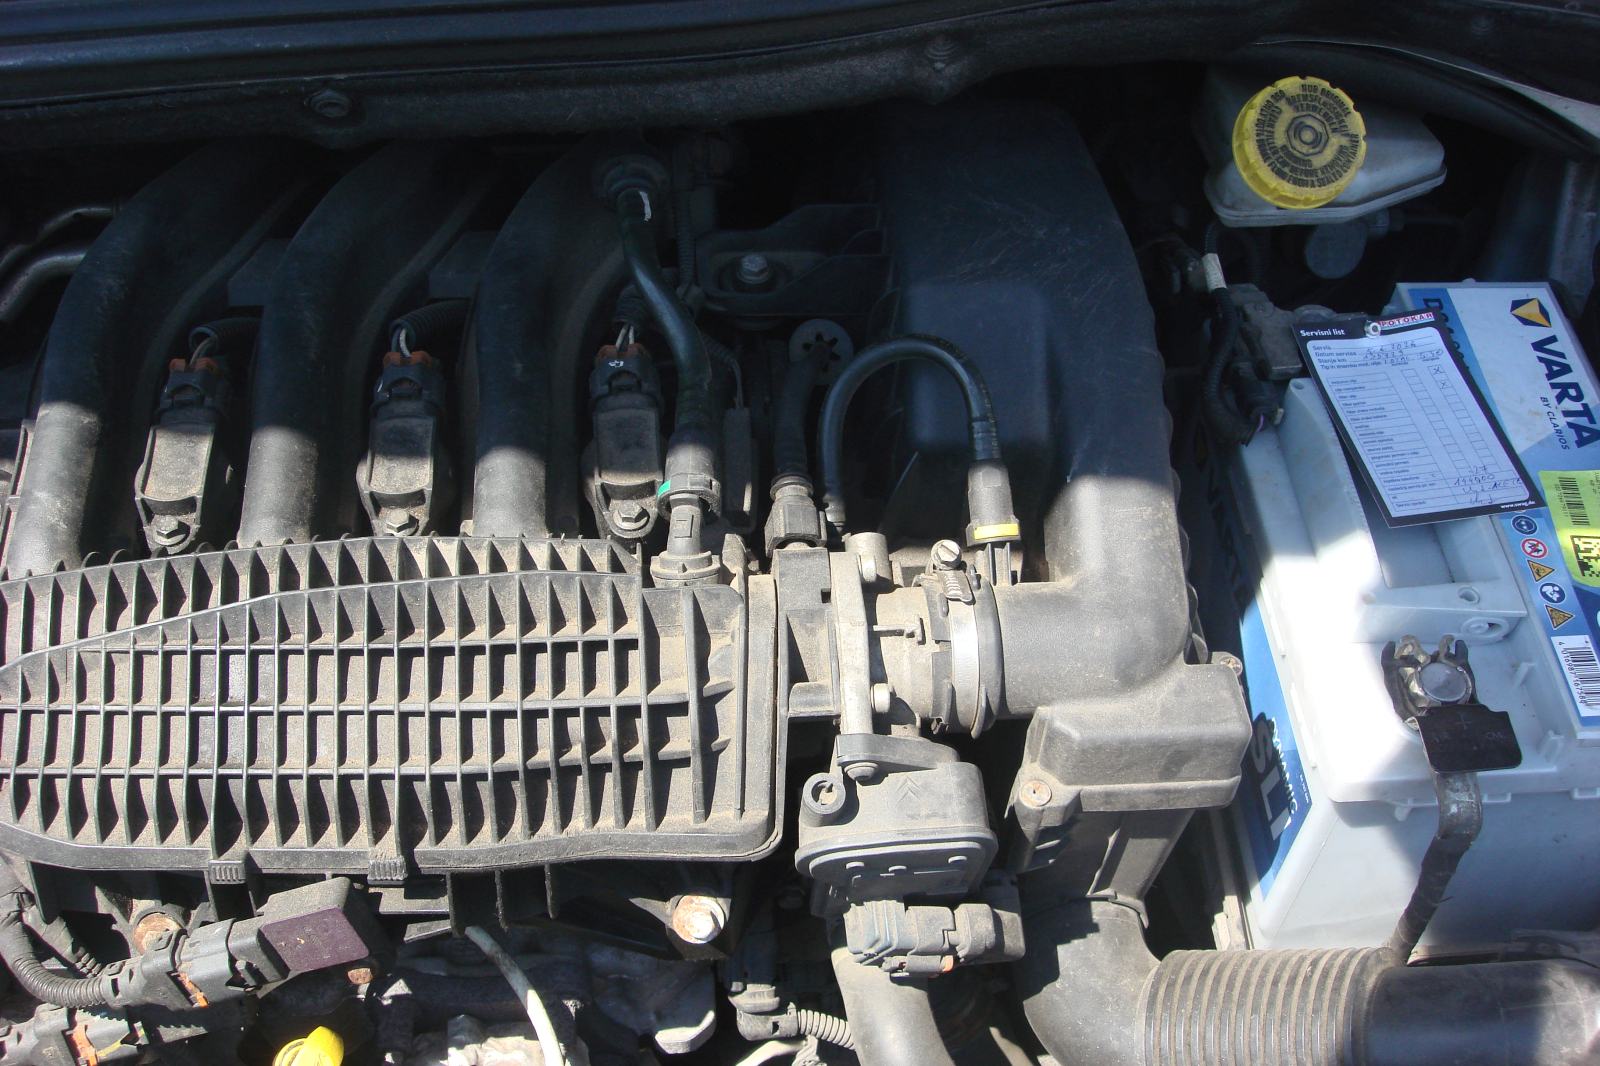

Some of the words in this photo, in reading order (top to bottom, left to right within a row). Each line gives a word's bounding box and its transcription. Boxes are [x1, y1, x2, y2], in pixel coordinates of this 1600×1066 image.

[1301, 84, 1318, 93] NUR
[1321, 87, 1351, 117] ORIGINAL
[1333, 328, 1345, 336] list
[1381, 313, 1433, 326] POTOKAR
[1531, 335, 1600, 448] VARTA
[1540, 396, 1552, 409] BY
[1547, 411, 1570, 450] CLARIOS
[1561, 650, 1576, 676] 016987
[1268, 717, 1298, 815] DYNAMIC
